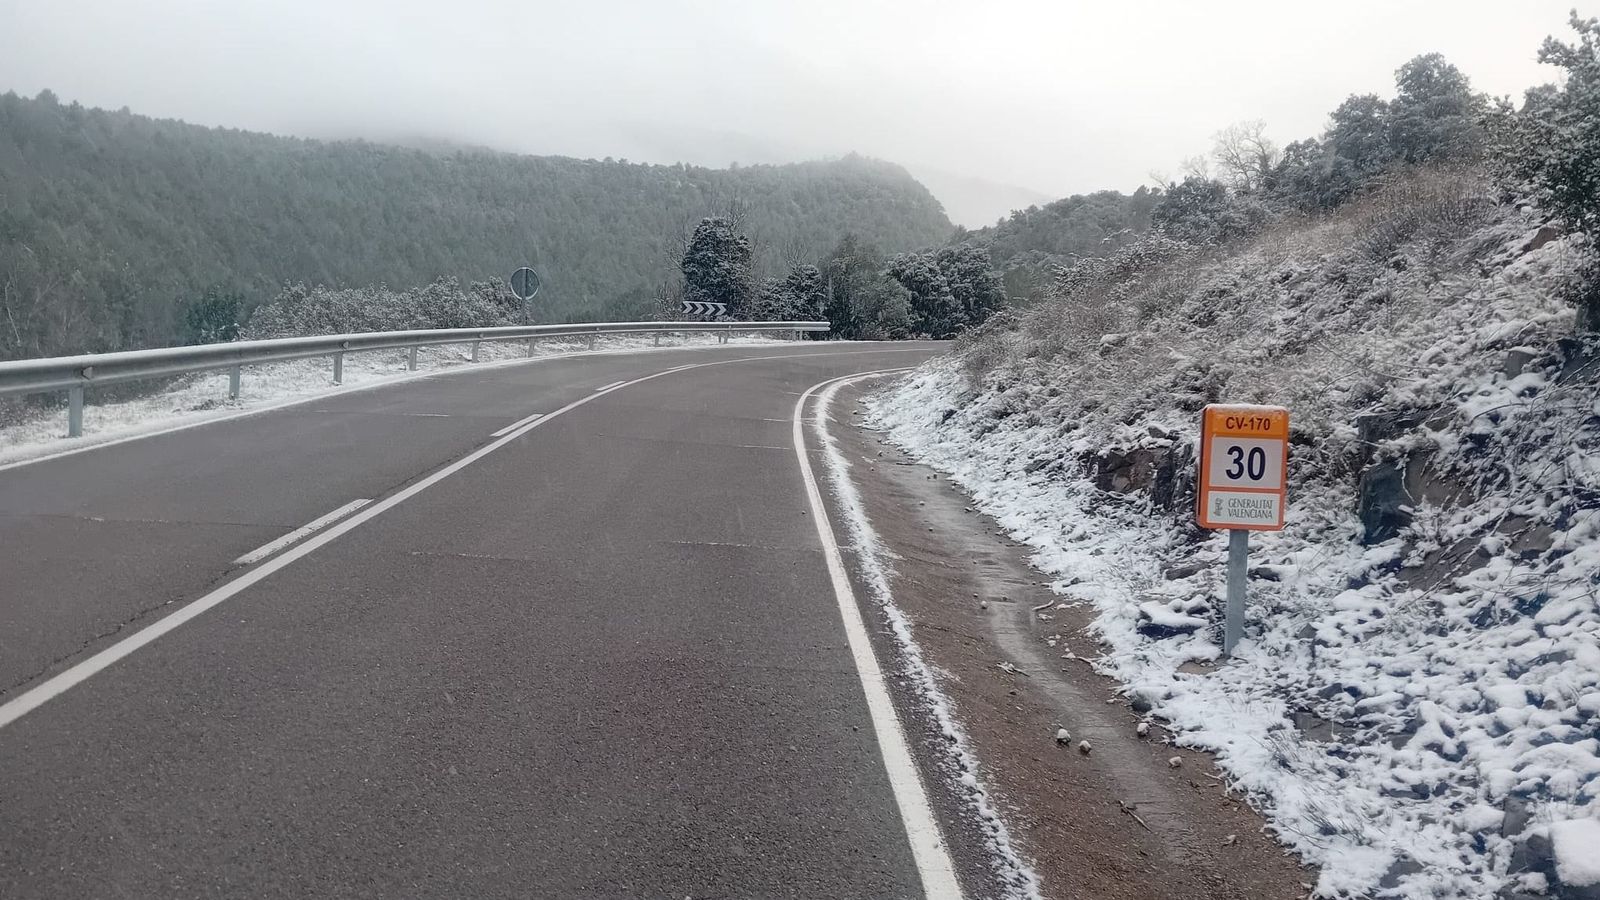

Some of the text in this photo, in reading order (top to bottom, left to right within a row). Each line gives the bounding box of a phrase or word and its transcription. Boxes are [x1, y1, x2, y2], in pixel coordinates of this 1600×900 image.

[1225, 416, 1271, 431] CV-170
[1225, 445, 1267, 481] 30
[1228, 498, 1273, 509] GENERALITAT
[1228, 508, 1273, 519] VALENCIANA
